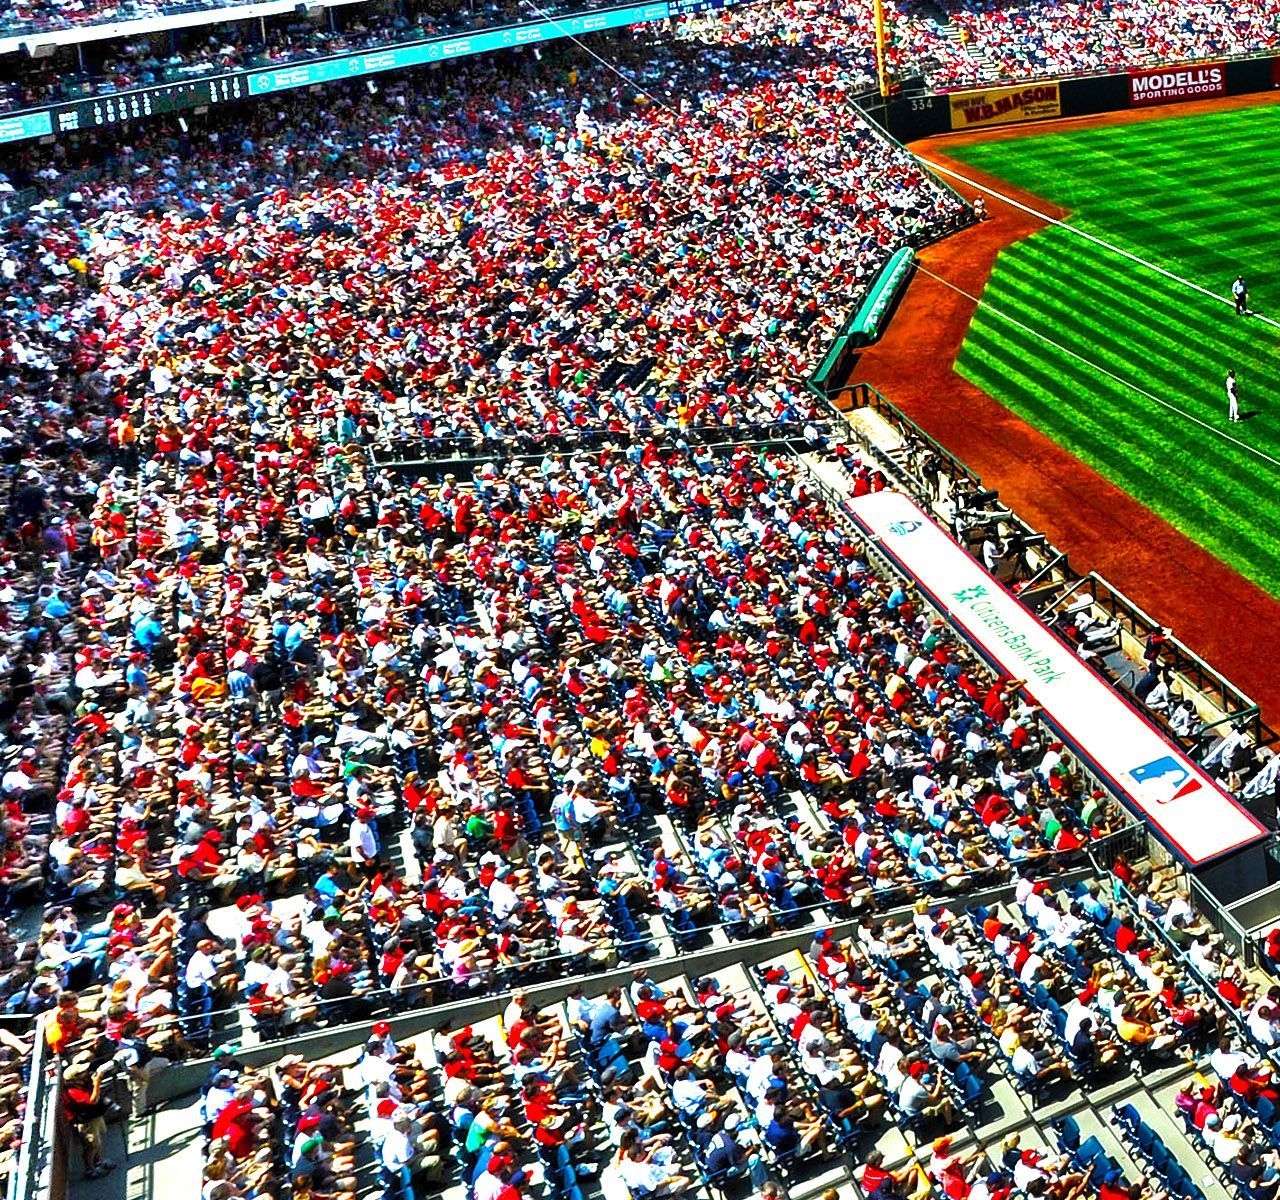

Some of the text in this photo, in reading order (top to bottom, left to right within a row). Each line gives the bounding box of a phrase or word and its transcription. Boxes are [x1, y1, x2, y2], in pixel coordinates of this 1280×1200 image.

[1132, 68, 1222, 92] MODELL'S
[1133, 83, 1223, 101] SPORTING GOODS
[911, 99, 933, 111] 334
[970, 601, 1066, 684] Citizens Bank Park
